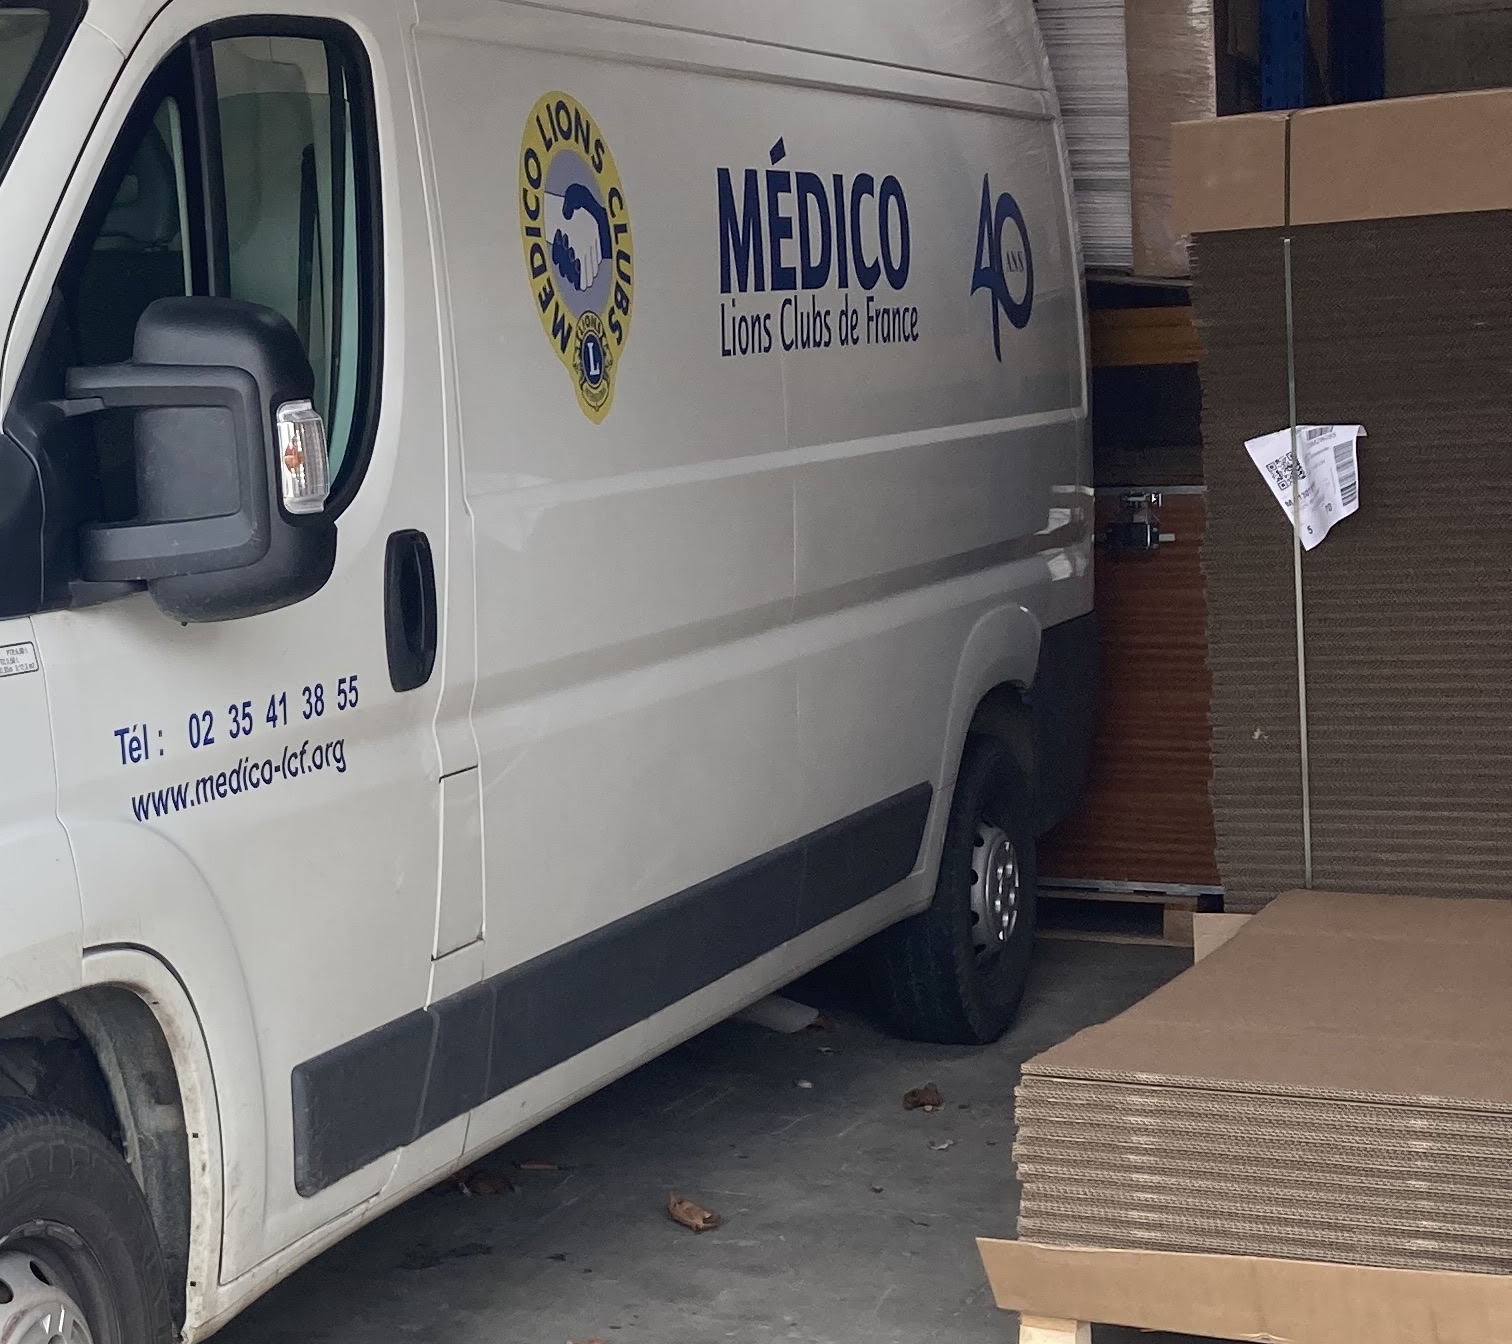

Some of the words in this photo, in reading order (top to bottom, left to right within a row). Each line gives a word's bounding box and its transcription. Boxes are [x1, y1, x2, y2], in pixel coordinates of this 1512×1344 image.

[536, 100, 605, 174] LIONS
[523, 146, 573, 354] MEDICO
[716, 136, 911, 295] MÉDICO
[608, 186, 632, 346] CLUBS
[586, 342, 600, 376] L
[719, 298, 773, 357] Lions
[780, 295, 832, 352] Clubs
[838, 293, 860, 346] de
[865, 296, 920, 344] France
[114, 724, 149, 766] Tél
[189, 711, 215, 749] 02
[228, 700, 253, 739] 35
[265, 692, 289, 730] 41
[302, 682, 325, 720] 38
[336, 674, 359, 711] 55
[131, 737, 347, 822] www.medico-lcf.org
